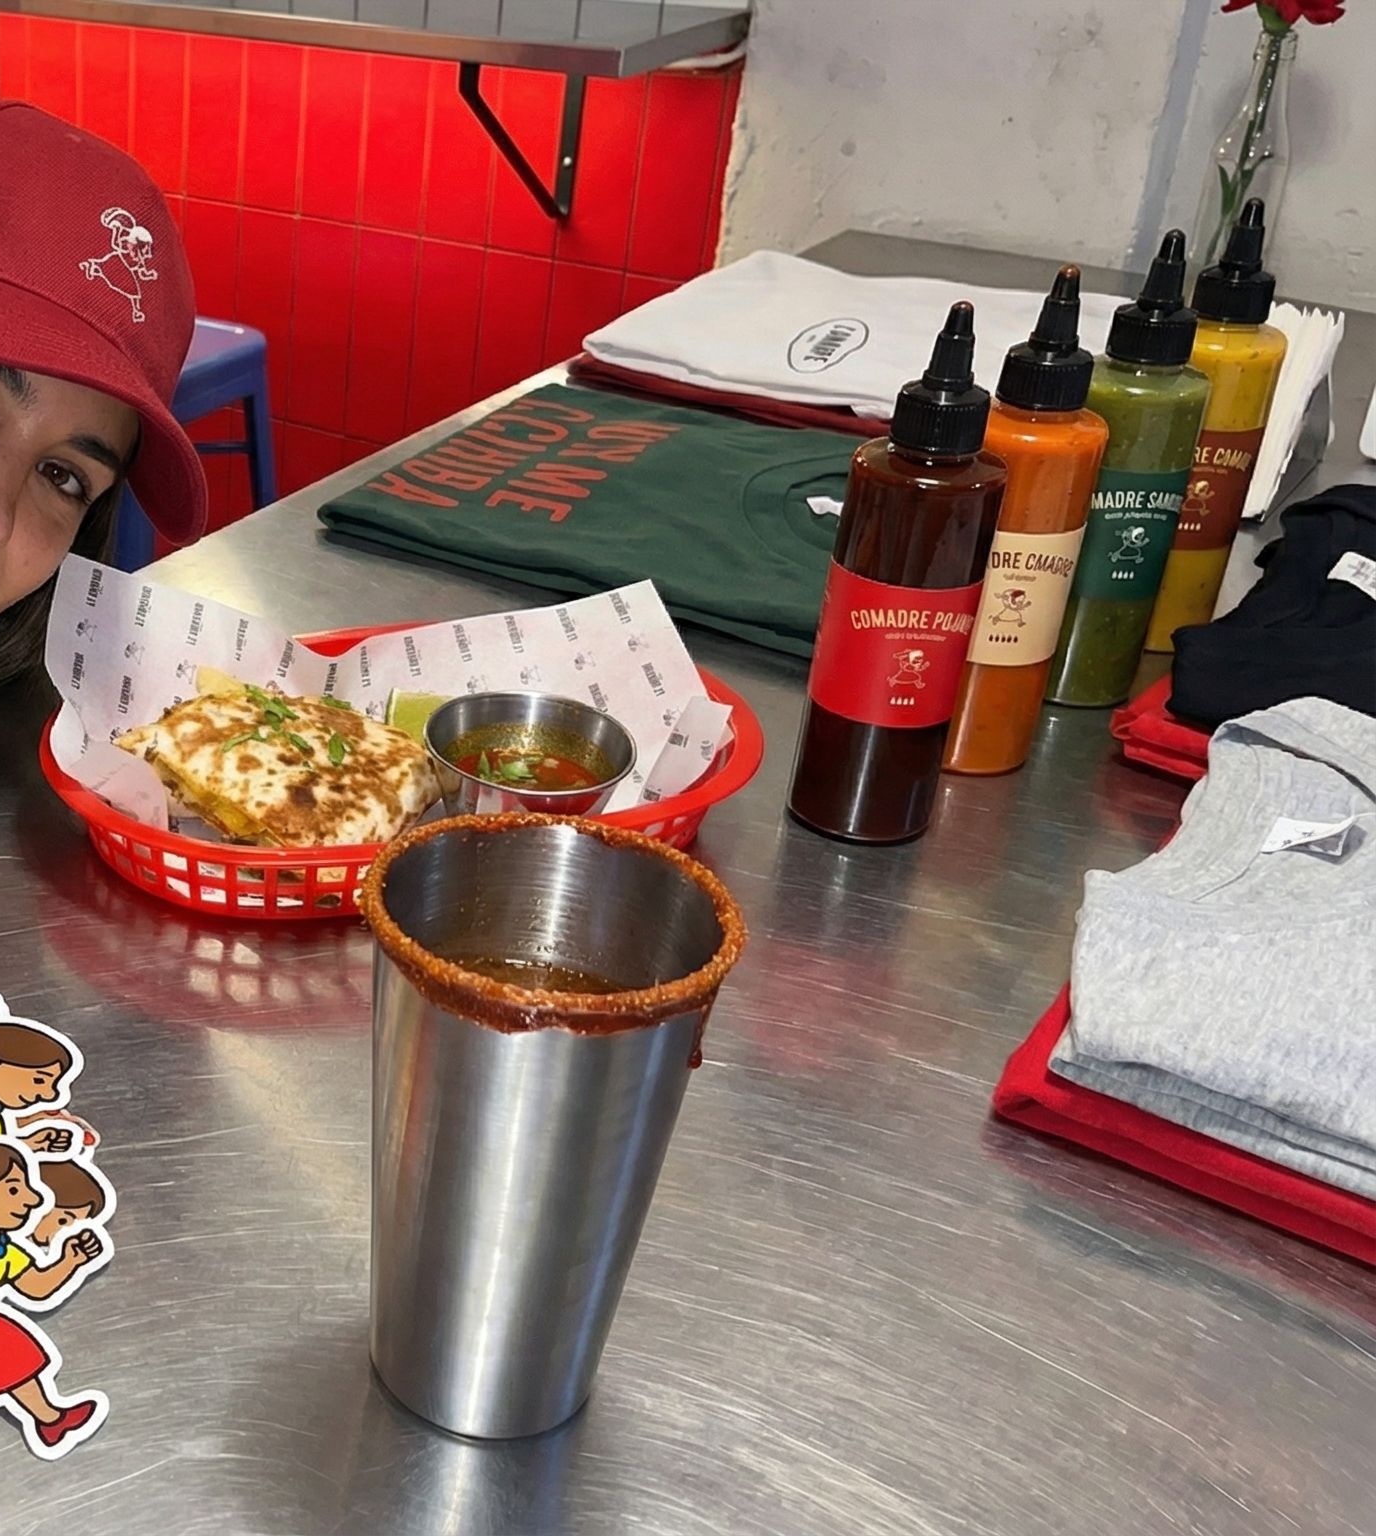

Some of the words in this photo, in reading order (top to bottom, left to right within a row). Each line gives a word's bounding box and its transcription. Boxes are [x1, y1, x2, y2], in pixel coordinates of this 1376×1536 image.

[485, 462, 608, 523] ME
[1091, 490, 1146, 510] MADRE
[986, 551, 1022, 570] DRE
[850, 608, 932, 630] COMADRE
